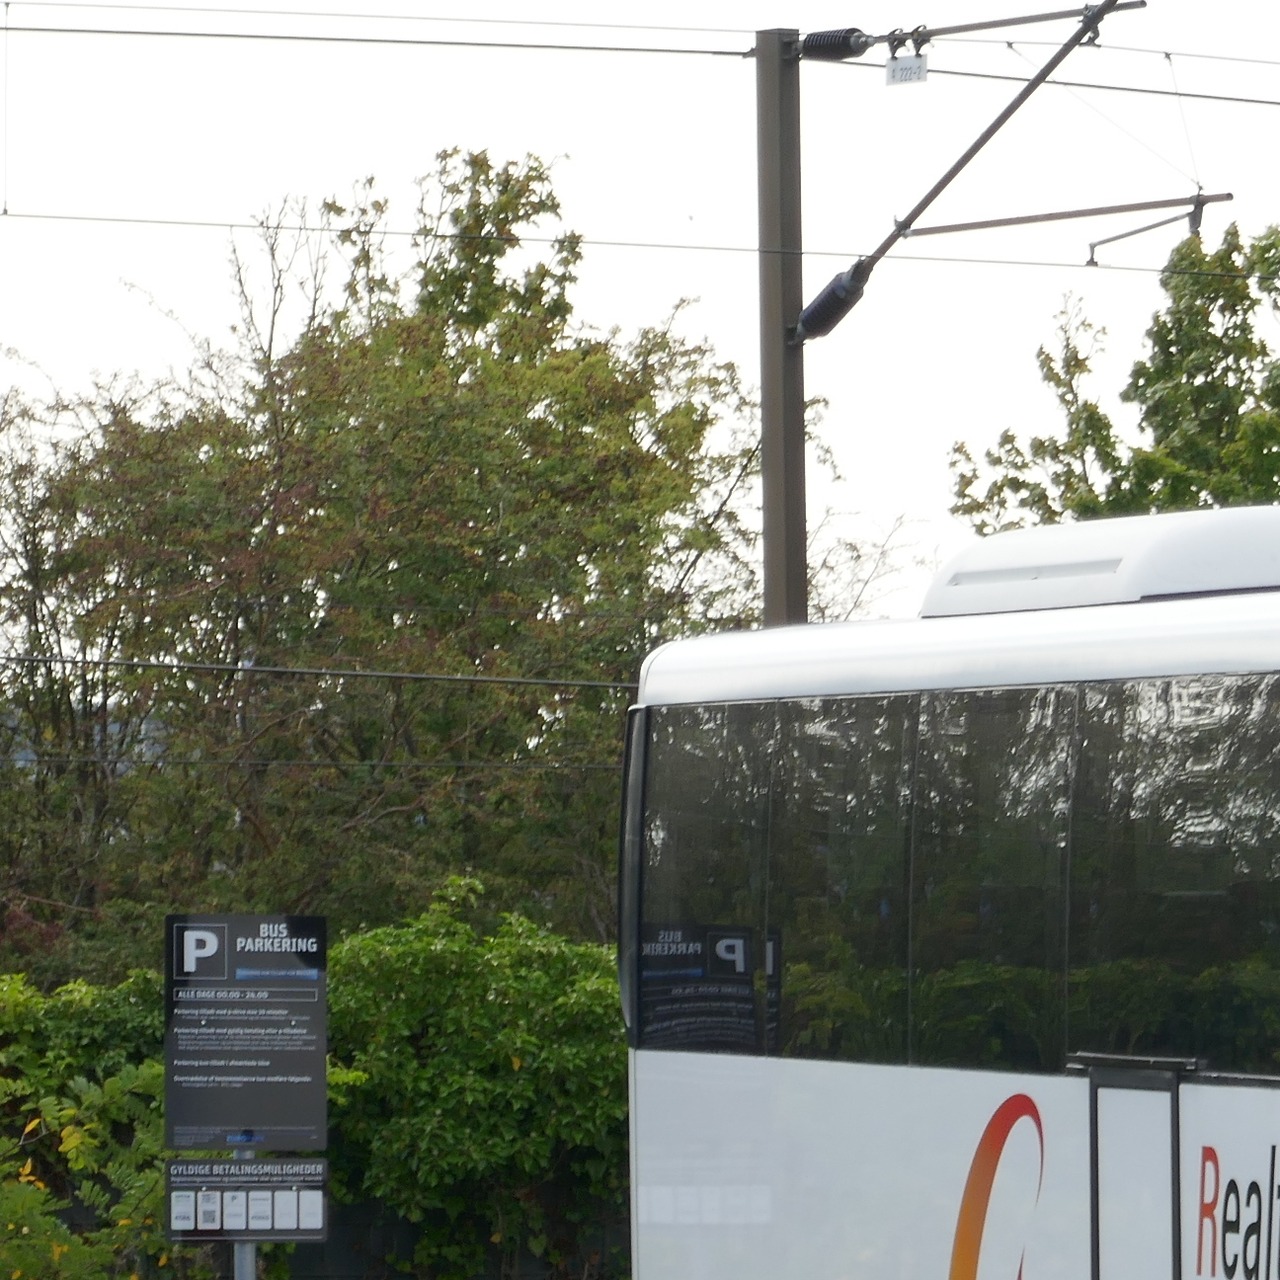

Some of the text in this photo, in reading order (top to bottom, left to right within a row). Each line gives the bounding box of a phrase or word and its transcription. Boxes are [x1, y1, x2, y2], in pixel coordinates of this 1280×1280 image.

[259, 923, 288, 938] BUS
[183, 930, 218, 973] P
[236, 937, 318, 953] PARKERING
[170, 1163, 324, 1175] GYLDIGE BETALINGSMULIGHEDER
